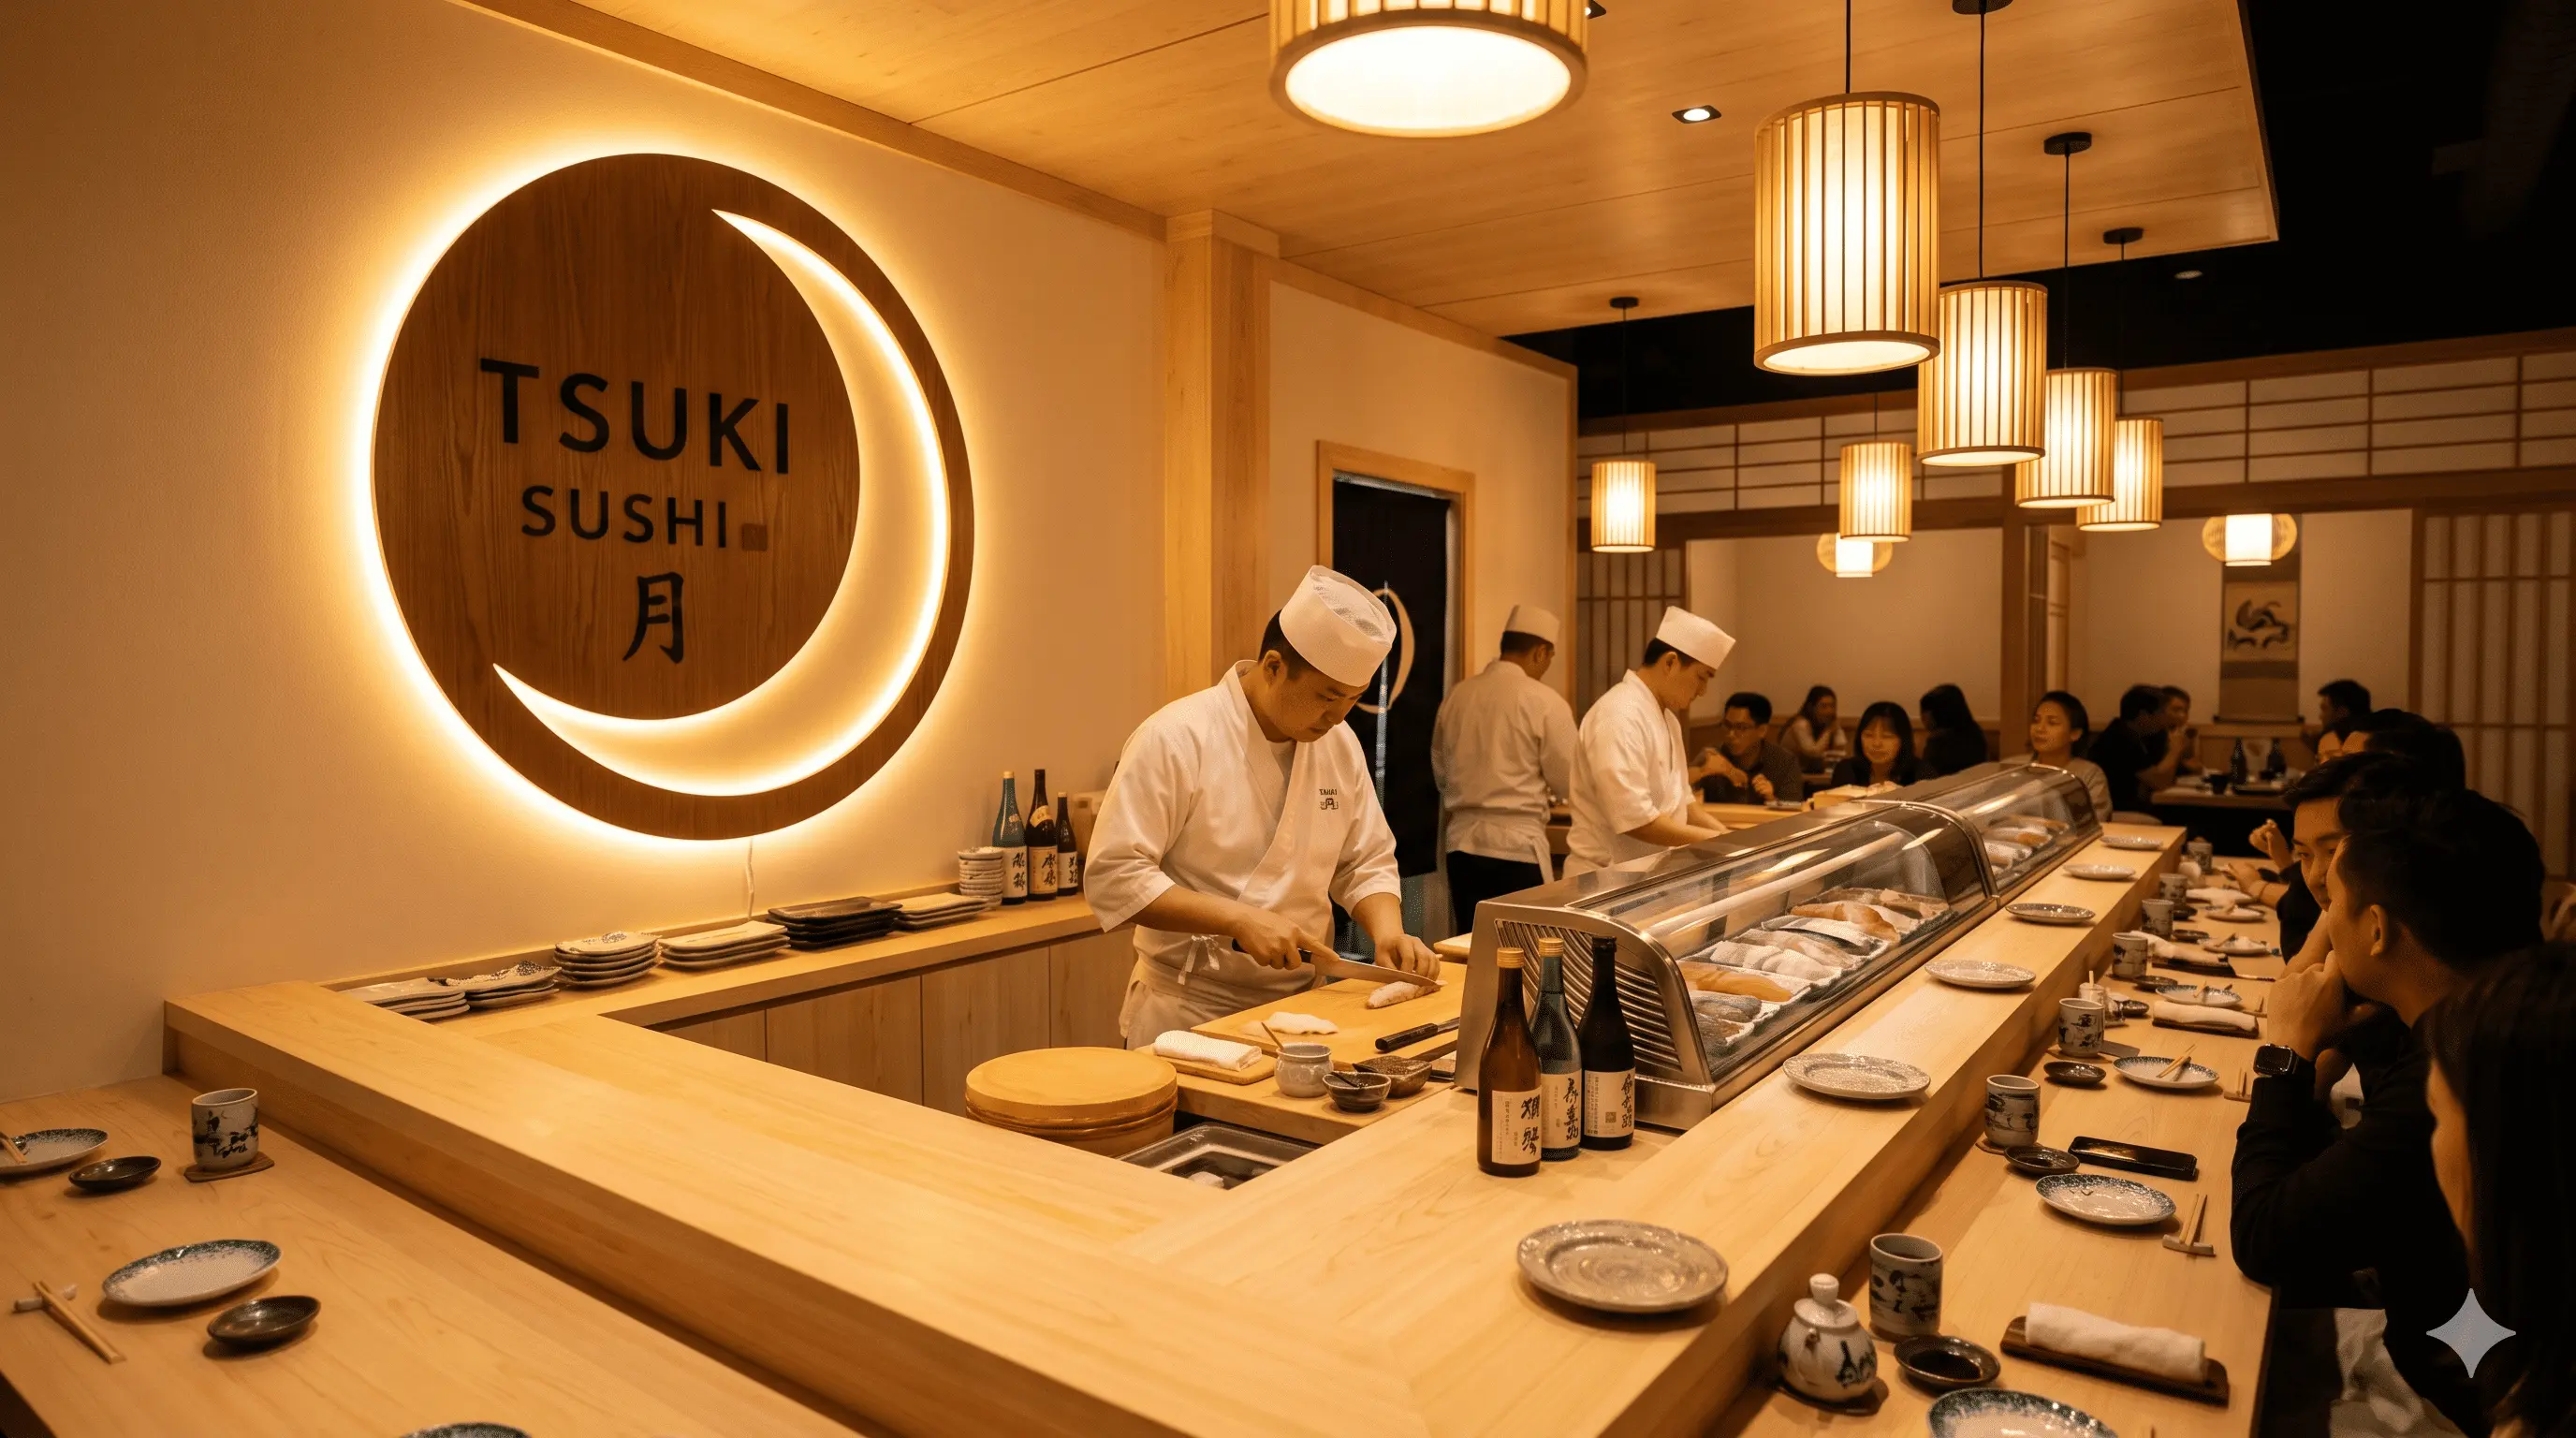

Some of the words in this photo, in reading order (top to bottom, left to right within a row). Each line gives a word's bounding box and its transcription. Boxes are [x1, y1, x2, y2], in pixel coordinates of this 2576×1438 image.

[479, 358, 789, 475] TSUKI
[521, 485, 726, 549] SUSHI
[622, 571, 684, 665] 月
